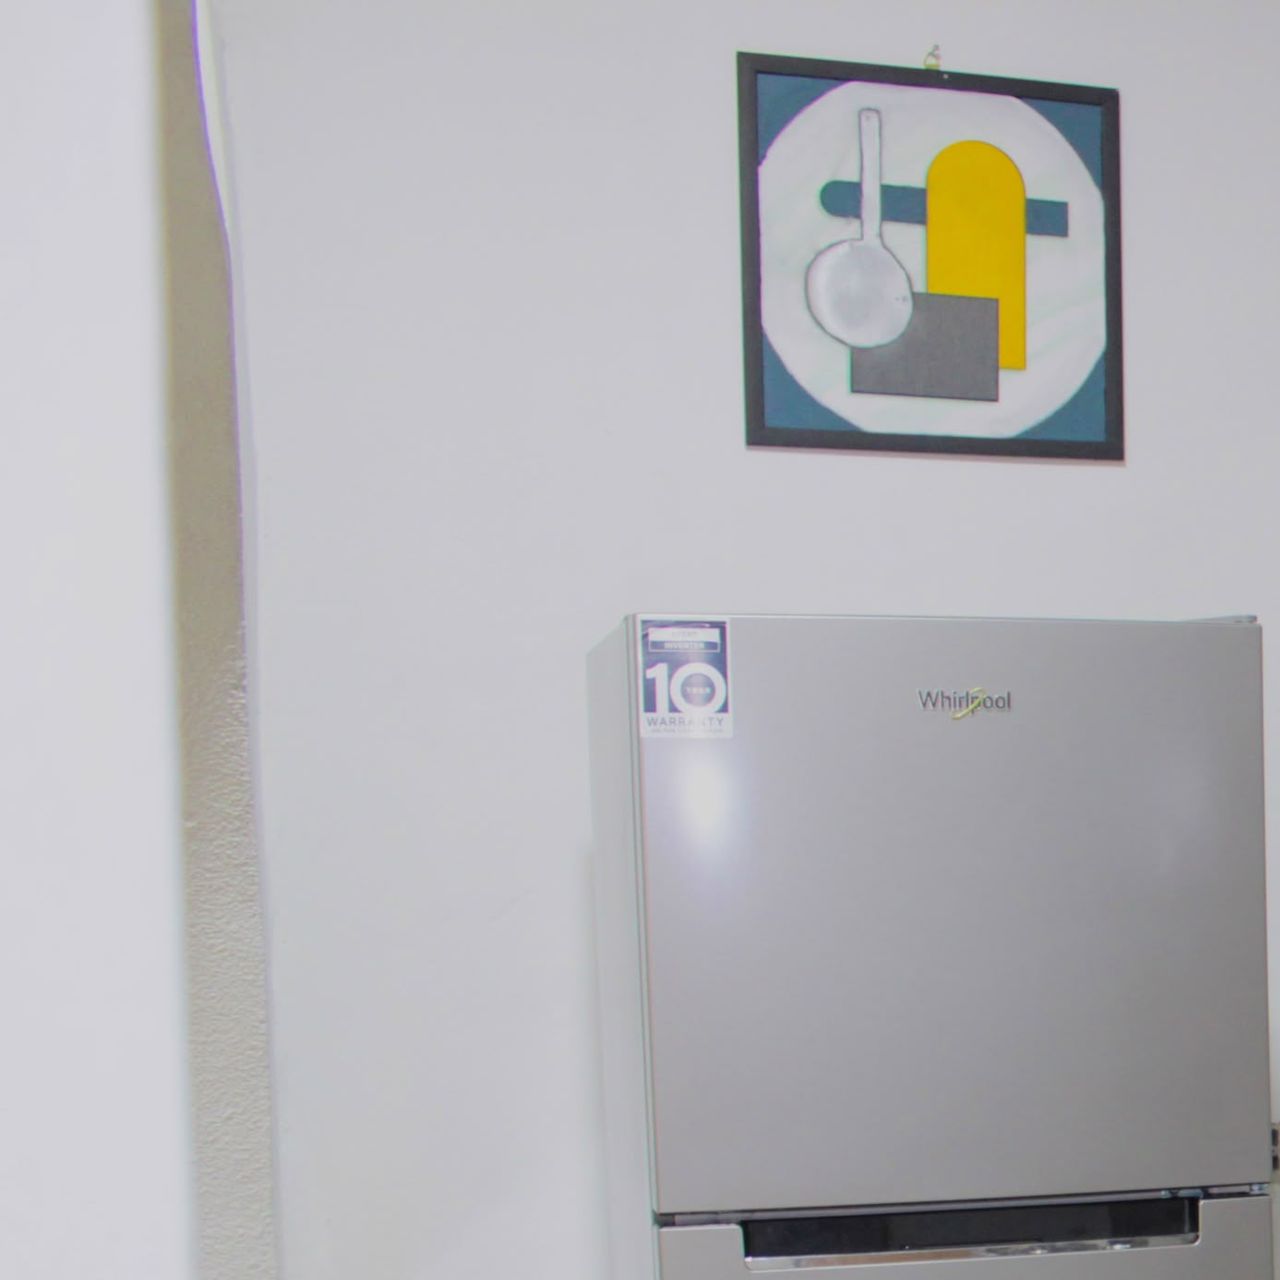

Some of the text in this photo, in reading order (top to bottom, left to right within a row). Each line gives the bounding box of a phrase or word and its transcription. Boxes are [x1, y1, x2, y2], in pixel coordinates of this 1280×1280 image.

[645, 662, 727, 713] 10
[918, 688, 1011, 715] Whirlpool
[647, 717, 724, 727] WARRATY
